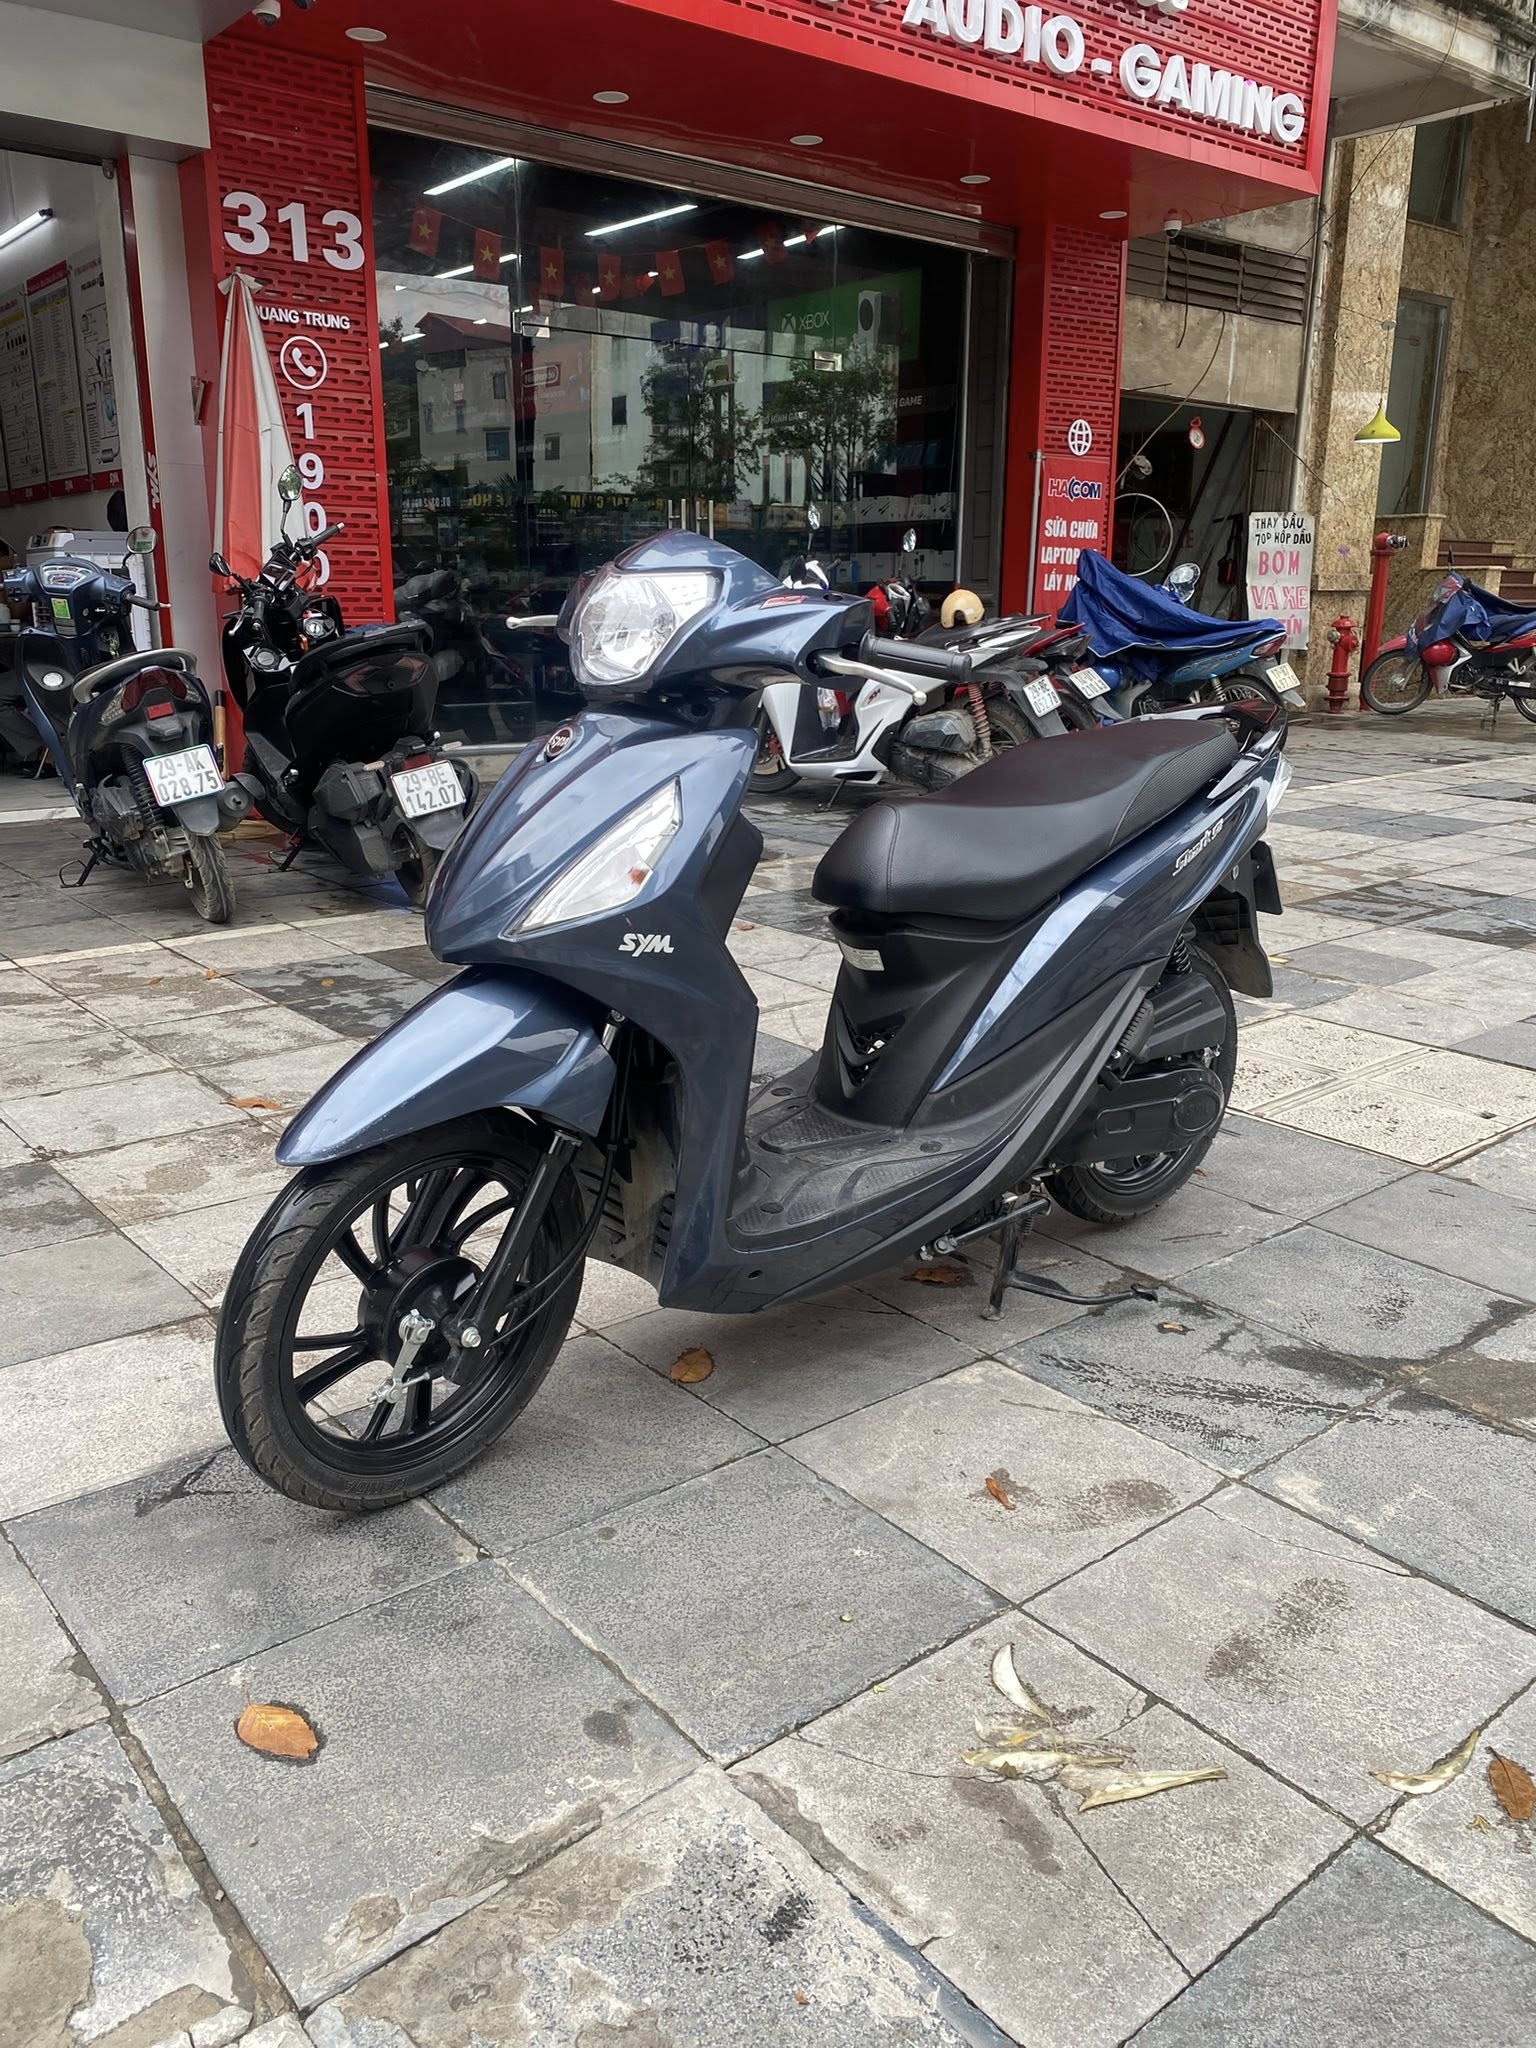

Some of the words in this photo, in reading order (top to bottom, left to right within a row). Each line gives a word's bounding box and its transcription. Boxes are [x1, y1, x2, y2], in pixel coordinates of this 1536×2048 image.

[1119, 43, 1305, 143] GAMING
[223, 191, 365, 271] 313
[256, 306, 299, 324] UANG
[303, 311, 350, 329] TRUNG
[799, 310, 830, 331] XBOX
[899, 395, 923, 407] GAME
[1254, 517, 1279, 530] THAY
[1282, 585, 1309, 610] XE
[154, 750, 206, 780] 29-AK
[157, 770, 219, 802] 028.75
[402, 766, 448, 793] 29-BE
[405, 784, 457, 814] 142.07
[618, 932, 675, 957] SYM
